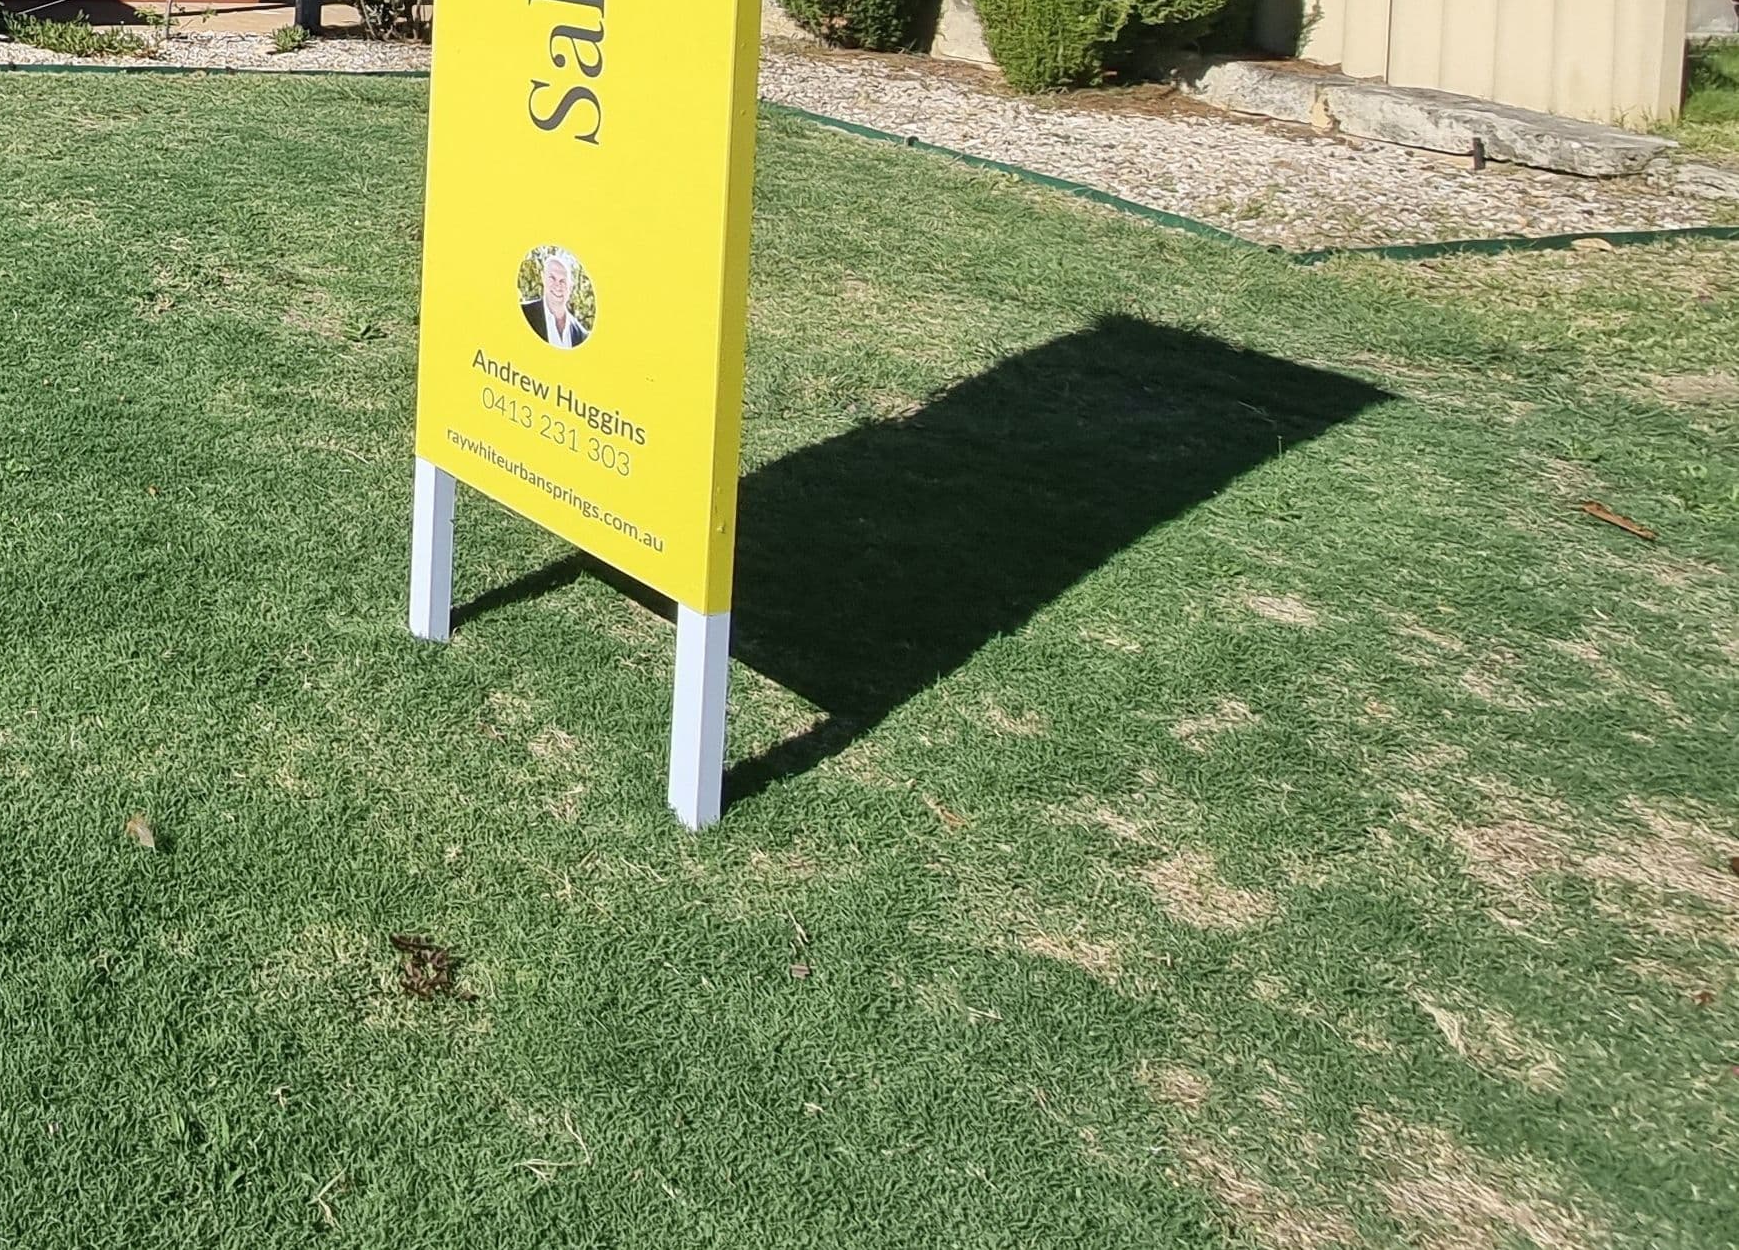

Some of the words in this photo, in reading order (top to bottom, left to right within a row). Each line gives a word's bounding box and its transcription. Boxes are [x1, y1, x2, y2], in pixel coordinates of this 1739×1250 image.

[471, 348, 550, 401] Andrew
[555, 384, 647, 446] Huggins
[481, 387, 533, 429] 0413
[540, 414, 579, 453] 231
[587, 437, 631, 478] 303
[446, 426, 664, 554] raywhiteurbansprings.com.au
